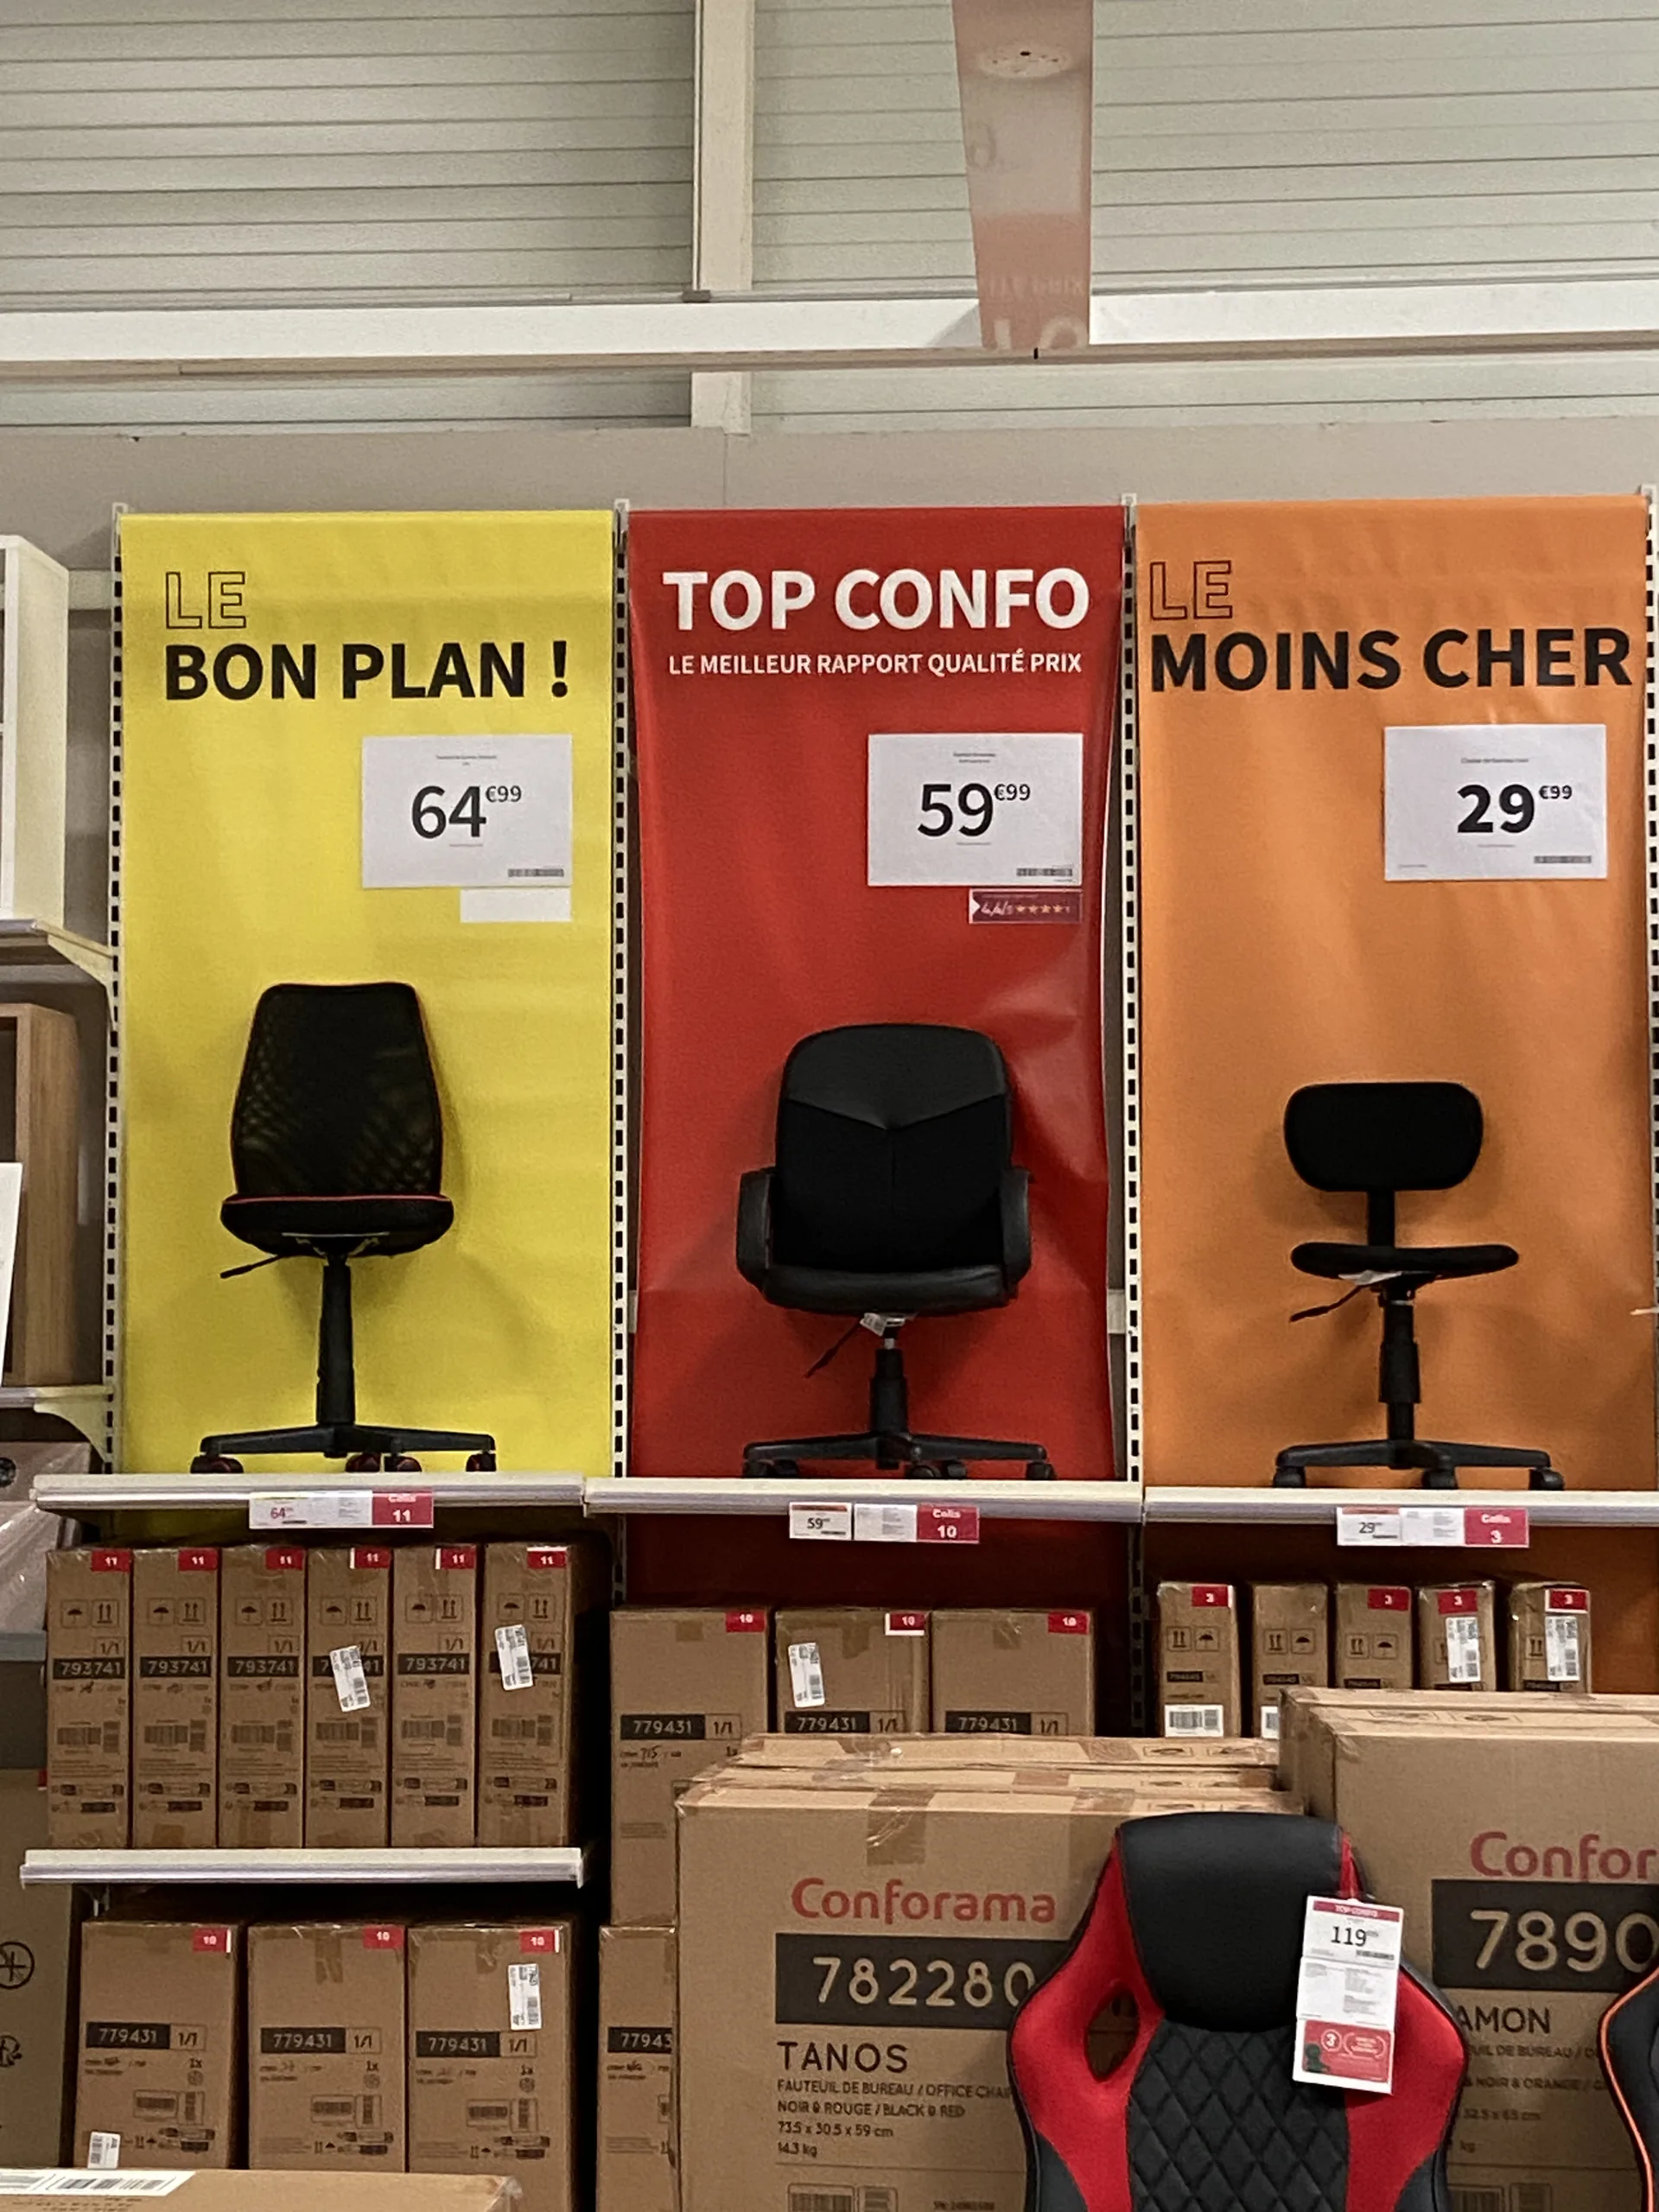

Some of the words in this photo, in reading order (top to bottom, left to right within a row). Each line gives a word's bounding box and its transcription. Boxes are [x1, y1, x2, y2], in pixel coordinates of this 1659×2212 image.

[1149, 560, 1233, 620] LE
[165, 571, 246, 629] LE
[663, 570, 815, 631] TOP
[836, 568, 1090, 630] CONFO
[669, 655, 695, 675] LE
[700, 654, 811, 675] MEILLEUR
[817, 654, 923, 674] RAPPORT
[927, 647, 1026, 677] QUALITÉ
[1030, 652, 1083, 673] PRIX
[1151, 630, 1402, 692] MOINS
[1423, 628, 1632, 688] CHER
[165, 644, 316, 700] BON
[342, 641, 524, 699] PLAN
[392, 1509, 411, 1522] 11
[938, 1524, 957, 1539] 10
[1490, 1529, 1503, 1544] 3
[100, 1642, 120, 1655] 1/1
[187, 1640, 207, 1654] 1/1
[273, 1639, 294, 1653] 1/1
[61, 1662, 121, 1676] 793741
[148, 1660, 208, 1675] 793741
[235, 1660, 296, 1675] 793741
[406, 1657, 467, 1672] 793741
[633, 1720, 692, 1735] 779431
[713, 1721, 734, 1736] 1/1
[798, 1716, 857, 1731] 779431
[958, 1717, 1017, 1732] 779431
[1471, 1831, 1658, 1884] Confor
[791, 1877, 1057, 1926] Conforama
[1331, 1926, 1367, 1947] 119
[812, 1956, 1035, 2008] 782280
[99, 2028, 157, 2044] 779431
[178, 2031, 198, 2046] 1/1
[273, 2033, 332, 2048] 779431
[354, 2035, 373, 2049] 1/1
[429, 2037, 487, 2052] 779431
[509, 2037, 528, 2053] 1/1
[1325, 2033, 1337, 2048] 3
[777, 2041, 908, 2074] TANOS
[778, 2078, 840, 2094] FAUTEUIL
[842, 2080, 858, 2094] DE
[863, 2082, 914, 2096] BUREAU
[925, 2083, 974, 2099] OFFICE
[778, 2100, 810, 2113] NOIR
[823, 2102, 872, 2115] ROUGE
[883, 2103, 925, 2116] BLACK
[940, 2104, 966, 2117] RED
[855, 2124, 871, 2137] 59
[874, 2126, 893, 2138] cm
[802, 2143, 818, 2158] kg
